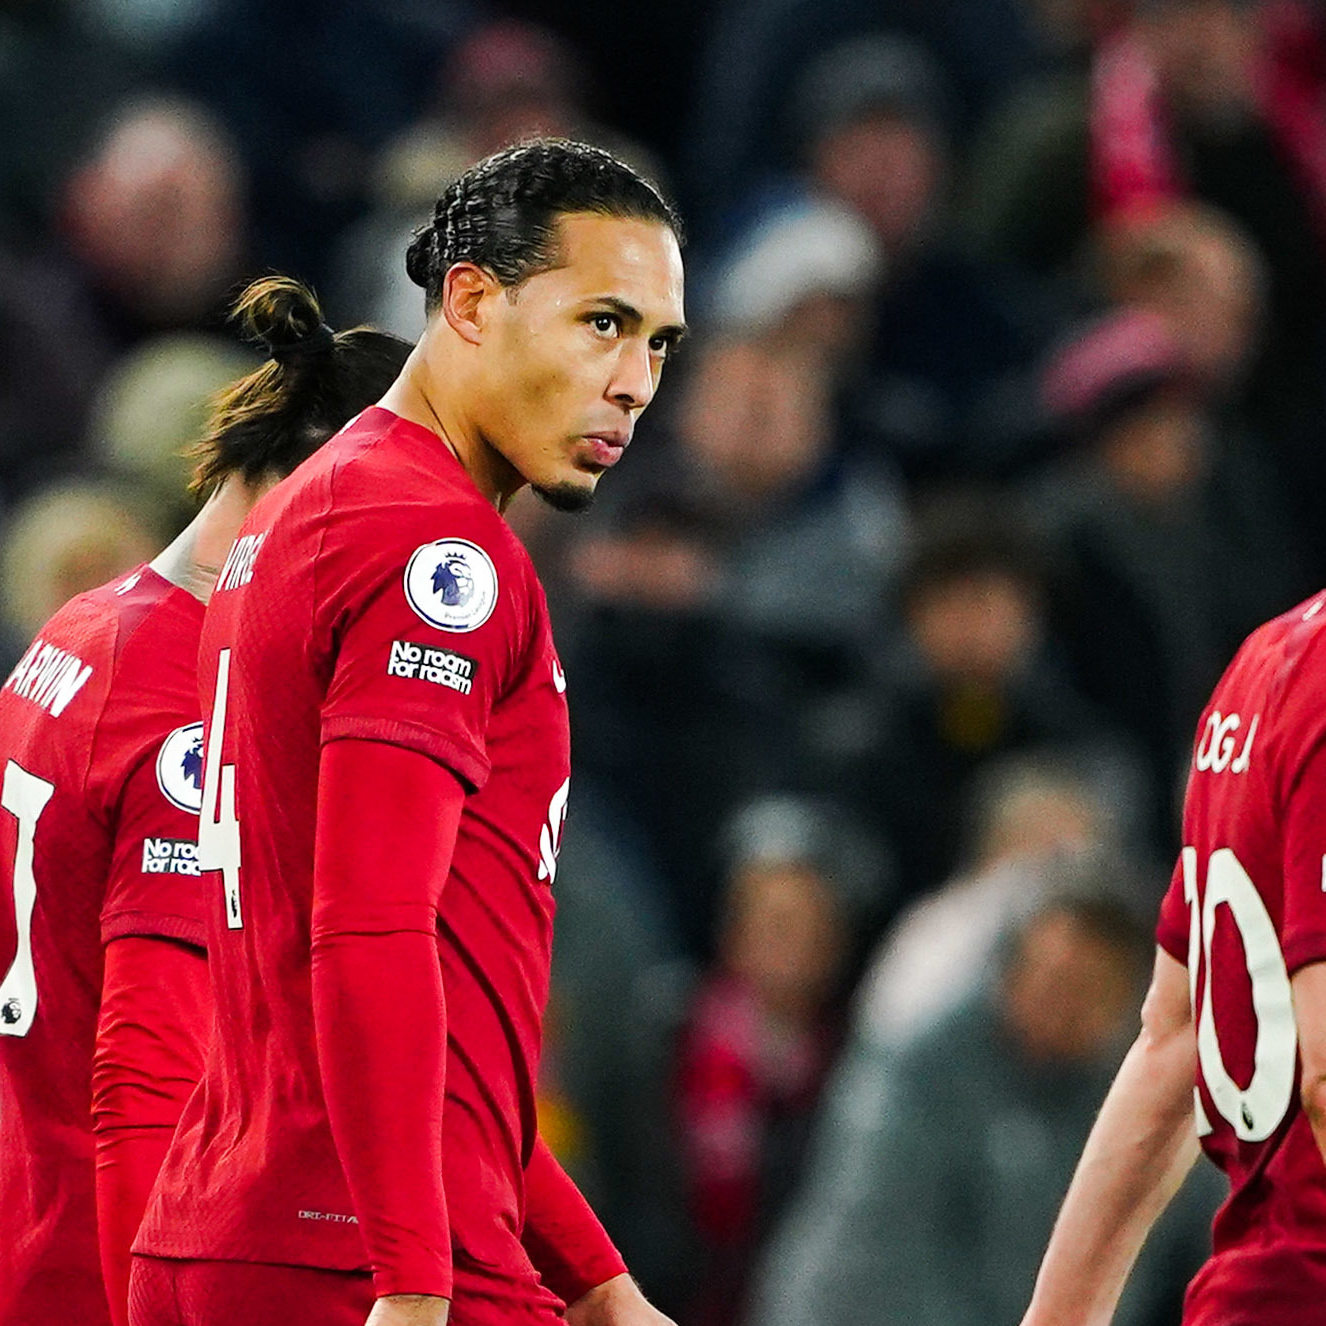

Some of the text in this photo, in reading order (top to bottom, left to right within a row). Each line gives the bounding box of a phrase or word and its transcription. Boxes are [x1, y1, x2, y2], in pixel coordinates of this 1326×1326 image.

[3, 638, 94, 718] ARWIN
[387, 656, 473, 695] for racism
[392, 640, 472, 678] No room
[198, 648, 243, 930] 4
[141, 854, 170, 873] for
[143, 838, 172, 858] No
